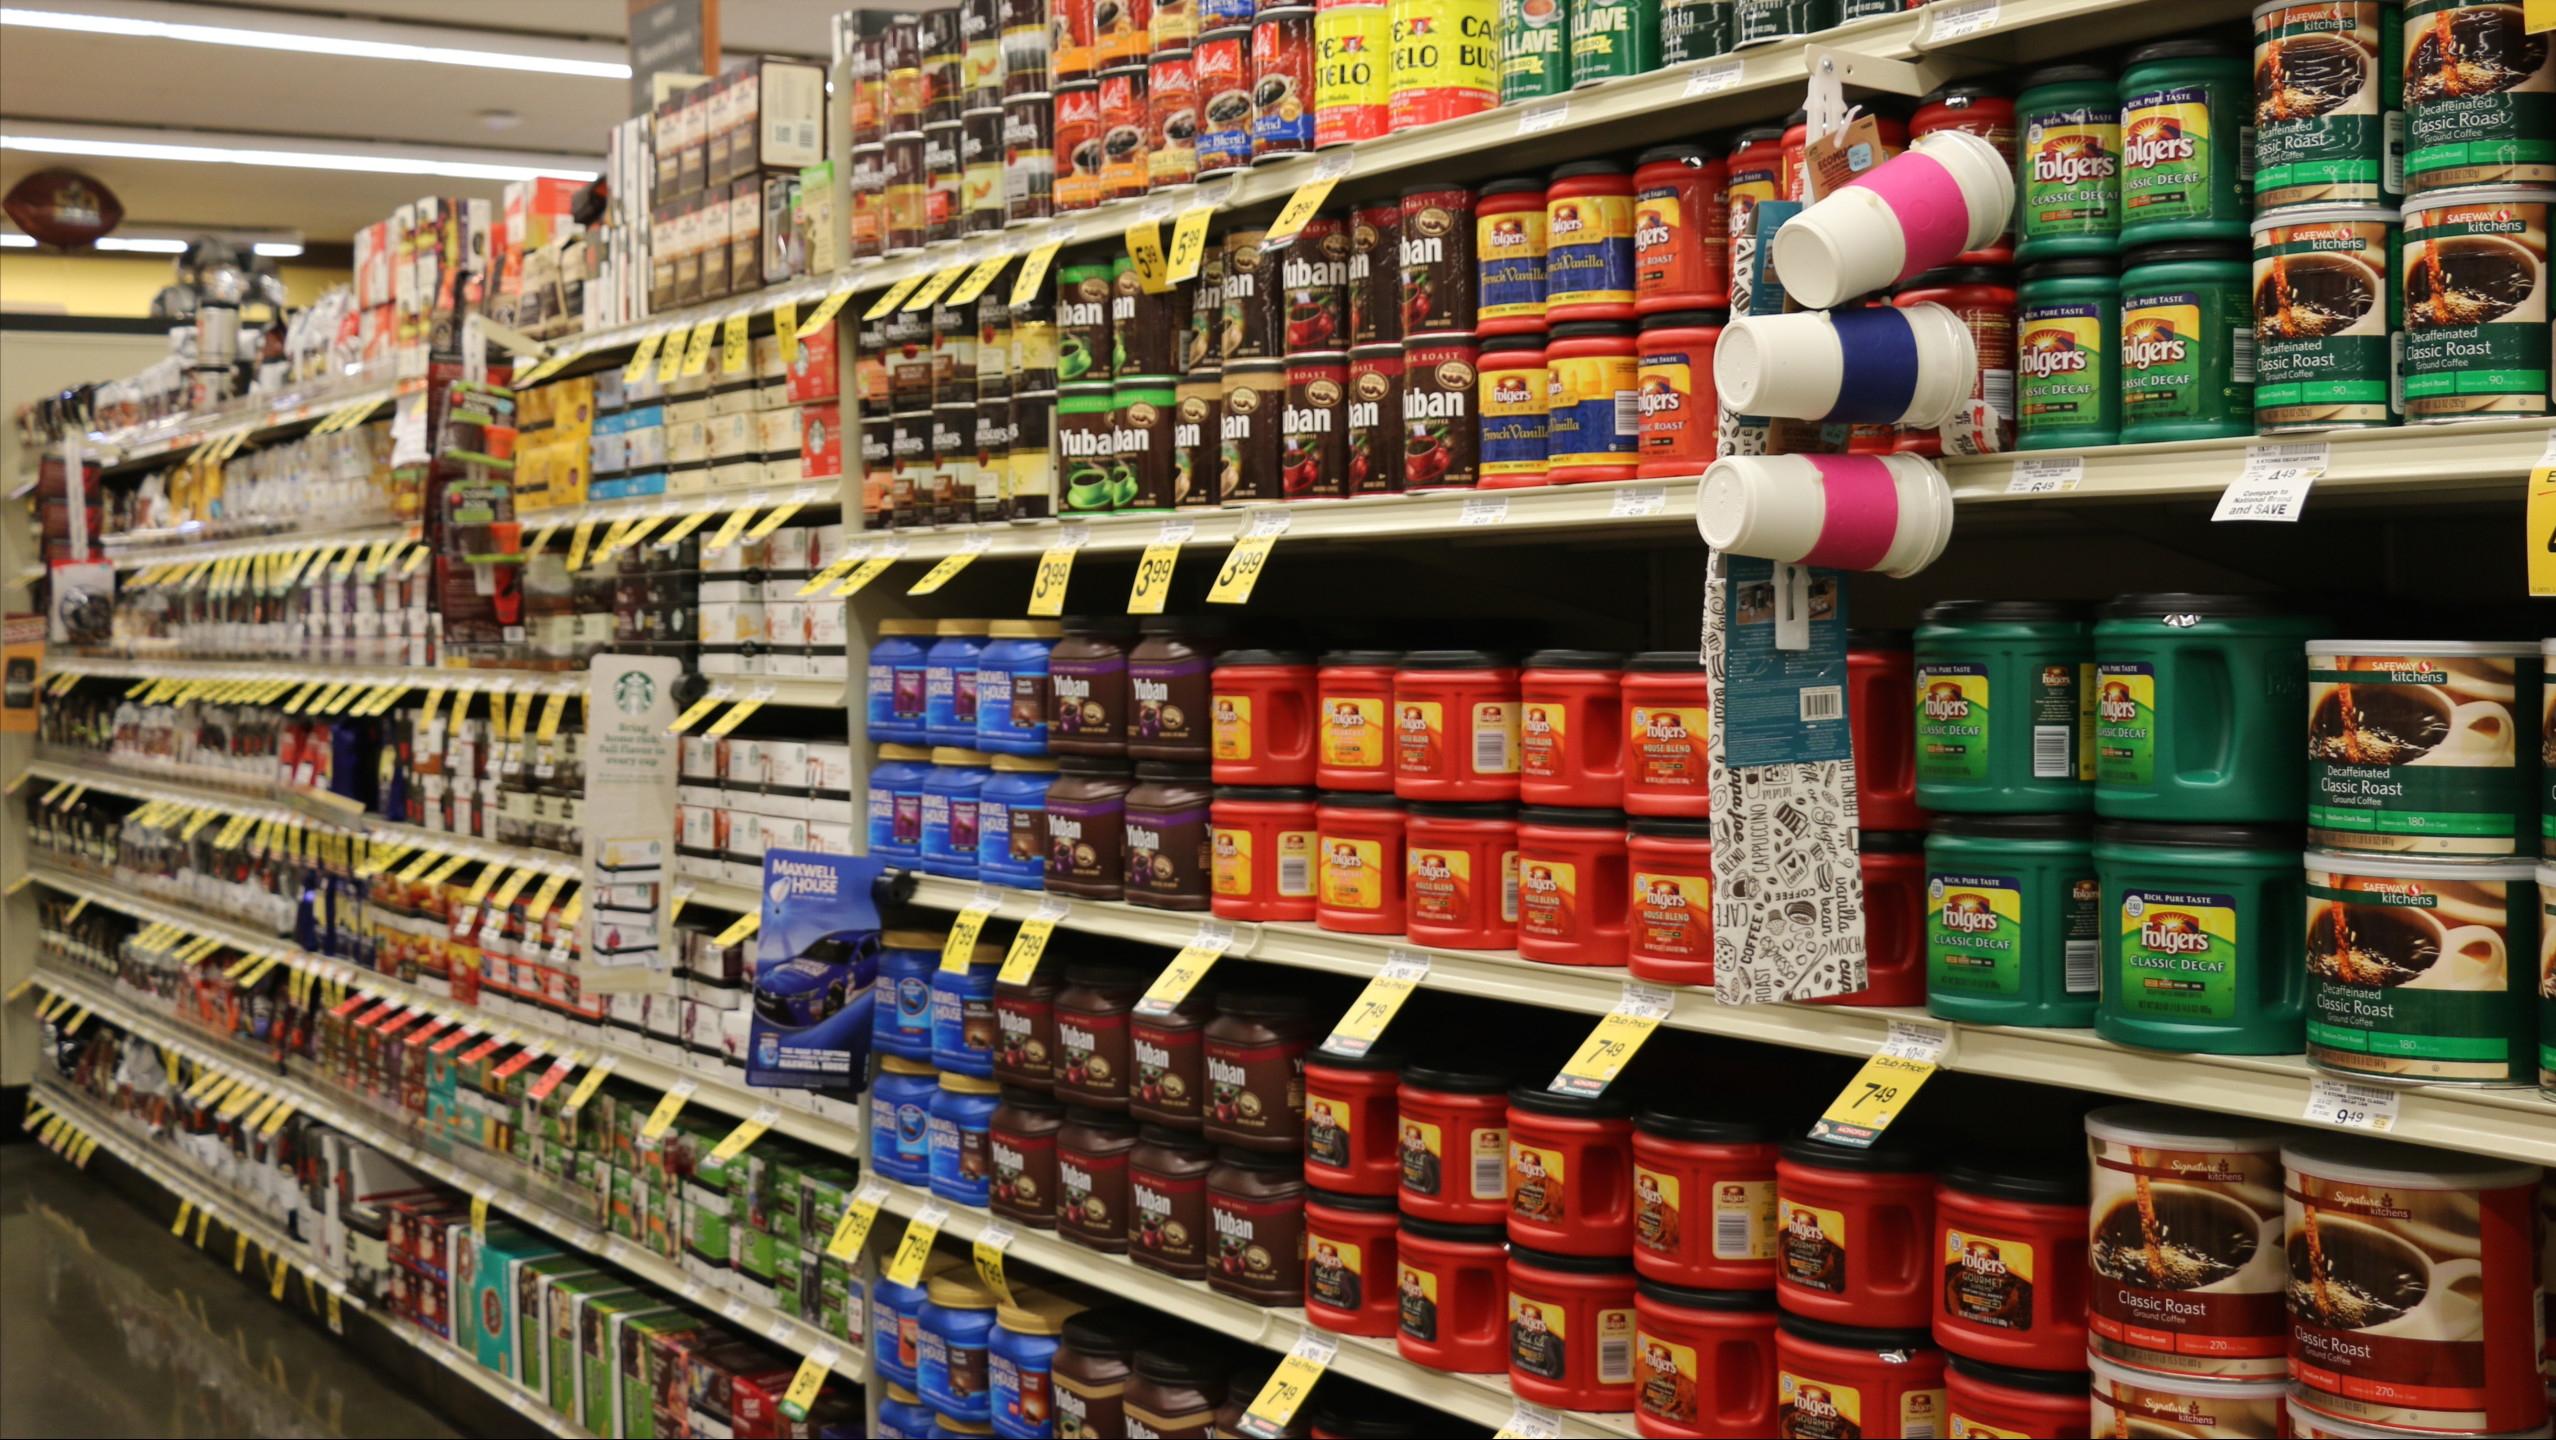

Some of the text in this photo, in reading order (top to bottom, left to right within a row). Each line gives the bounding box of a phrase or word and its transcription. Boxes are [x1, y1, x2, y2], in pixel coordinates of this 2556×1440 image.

[2285, 10, 2330, 25] SAFEWAY
[2303, 18, 2355, 32] kitchens
[2166, 92, 2192, 102] TASTE
[2418, 97, 2494, 118] Decaffeinated
[2411, 110, 2508, 136] Classic Roast
[1212, 134, 1246, 150] Blend
[2284, 133, 2328, 151] Roast
[2424, 127, 2485, 144] Ground Coffee
[2123, 136, 2196, 169] Folgers
[2033, 150, 2116, 185] Folgers
[2157, 172, 2200, 186] DECAF
[2031, 192, 2076, 207] CLASSIC
[2446, 211, 2496, 225] SAFEWAY
[2467, 219, 2522, 234] kitchens
[1490, 226, 1528, 250] Folgers
[2293, 230, 2340, 242] SAFEWAY
[2311, 238, 2364, 251] kitchens
[1177, 228, 1200, 266] 599
[1562, 252, 1605, 271] Vanilla
[2159, 295, 2184, 305] TASTE
[2040, 307, 2085, 318] PURE TASTE
[2411, 327, 2479, 344] Decaffeinated
[1421, 352, 1459, 363] ROAST
[2120, 338, 2187, 370] Folgers
[2260, 340, 2323, 357] Decaffeinated
[2406, 340, 2492, 361] Classic Roast
[2018, 348, 2088, 379] Folgers
[2256, 353, 2336, 373] Classic Roast
[2415, 358, 2470, 371] Ground Coffee
[2151, 374, 2192, 387] DECAF
[2288, 369, 2315, 381] Coffee
[2488, 375, 2505, 386] 90
[1493, 386, 1533, 407] Folgers
[2052, 384, 2092, 396] DECAF
[2332, 385, 2347, 396] 90
[1654, 420, 1684, 432] ROAST
[2228, 504, 2288, 516] and SAVE
[1135, 559, 1172, 598] 399
[1220, 550, 1263, 588] 399
[1036, 562, 1067, 599] 399
[2371, 660, 2419, 673] SAFEWAY
[1053, 675, 1090, 698] Yuban
[2391, 671, 2443, 684] kitchens
[1132, 678, 1169, 701] Yuban
[1924, 693, 1969, 722] Folgers
[1646, 720, 1687, 742] Folgers
[1949, 725, 1982, 737] DECAF
[2117, 728, 2147, 740] DECAF
[1643, 744, 1691, 754] HOUSE BLEND
[2327, 764, 2391, 779] Decaffeinated
[2321, 777, 2403, 796] Classic Roast
[2333, 795, 2382, 807] Ground Coffee
[1048, 814, 1082, 839] Yuban
[1727, 808, 1748, 845] joe
[2407, 815, 2426, 827] 180
[1125, 825, 1160, 850] Yuban
[1750, 803, 1770, 874] CAPPUCCINO
[771, 859, 840, 880] MAXWELL
[1717, 847, 1747, 876] BLEND
[791, 877, 839, 895] HOUSE
[1961, 877, 2001, 888] PURE TASTE
[2363, 882, 2408, 895] SAFEWAY
[1646, 886, 1686, 910] Folgers
[1775, 887, 1816, 901] COFFEE
[2143, 892, 2213, 906] RICH, PURE TASTE
[2381, 892, 2433, 907] kitchens
[1835, 876, 1857, 934] vanilla
[1643, 911, 1690, 922] HOUSE BLEND
[1819, 899, 1834, 938] bean
[1942, 903, 1998, 934] Folgers
[945, 921, 976, 958] 799
[1740, 914, 1765, 965] COFFEE
[1934, 934, 2012, 951] CLASSIC DECAF
[2140, 920, 2210, 955] Folgers
[1009, 932, 1043, 967] 799
[2129, 955, 2225, 974] CLASSIC DECAF
[2322, 981, 2382, 1001] Decaffeinated
[1353, 1002, 1388, 1025] 749
[2316, 993, 2395, 1019] Classic Roast
[998, 1008, 1032, 1036] Yuban
[2350, 1015, 2374, 1028] Coffee
[1059, 1024, 1095, 1052] Yuban
[2400, 1039, 2417, 1051] 180
[1134, 1039, 1170, 1069] Yuban
[1585, 1039, 1626, 1064] 749
[1206, 1057, 1246, 1086] Yuban
[1875, 1057, 1898, 1067] Club
[1851, 1082, 1898, 1110] 749
[2334, 1108, 2365, 1125] 949
[991, 1143, 1025, 1171] Yuban
[2170, 1158, 2218, 1175] Signature
[1060, 1164, 1092, 1192] Yuban
[2207, 1170, 2243, 1183] kitchens
[1133, 1184, 1172, 1215] Yuban
[2334, 1190, 2380, 1208] Signature
[2369, 1206, 2409, 1220] kitchens
[835, 1210, 869, 1246] 799
[1212, 1207, 1254, 1240] Yuban
[1789, 1214, 1824, 1241] Folgers
[897, 1233, 928, 1267] 799
[1961, 1246, 2006, 1275] Folgers
[1961, 1271, 2004, 1289] GOURMET
[2117, 1290, 2207, 1316] Classic Roast
[2132, 1309, 2187, 1325] Ground Coffee
[2209, 1339, 2227, 1352] 270
[2295, 1324, 2372, 1359] Classic Roast
[1645, 1355, 1678, 1376] Folgers
[2304, 1345, 2352, 1368] Ground Coffee
[1267, 1380, 1298, 1405] 749
[2375, 1384, 2394, 1399] 270
[1054, 1386, 1087, 1419] Yuban
[1793, 1390, 1838, 1418] Folgers
[2144, 1395, 2189, 1415] Signature
[1794, 1413, 1836, 1431] GOURMET
[2178, 1410, 2214, 1426] kitchens
